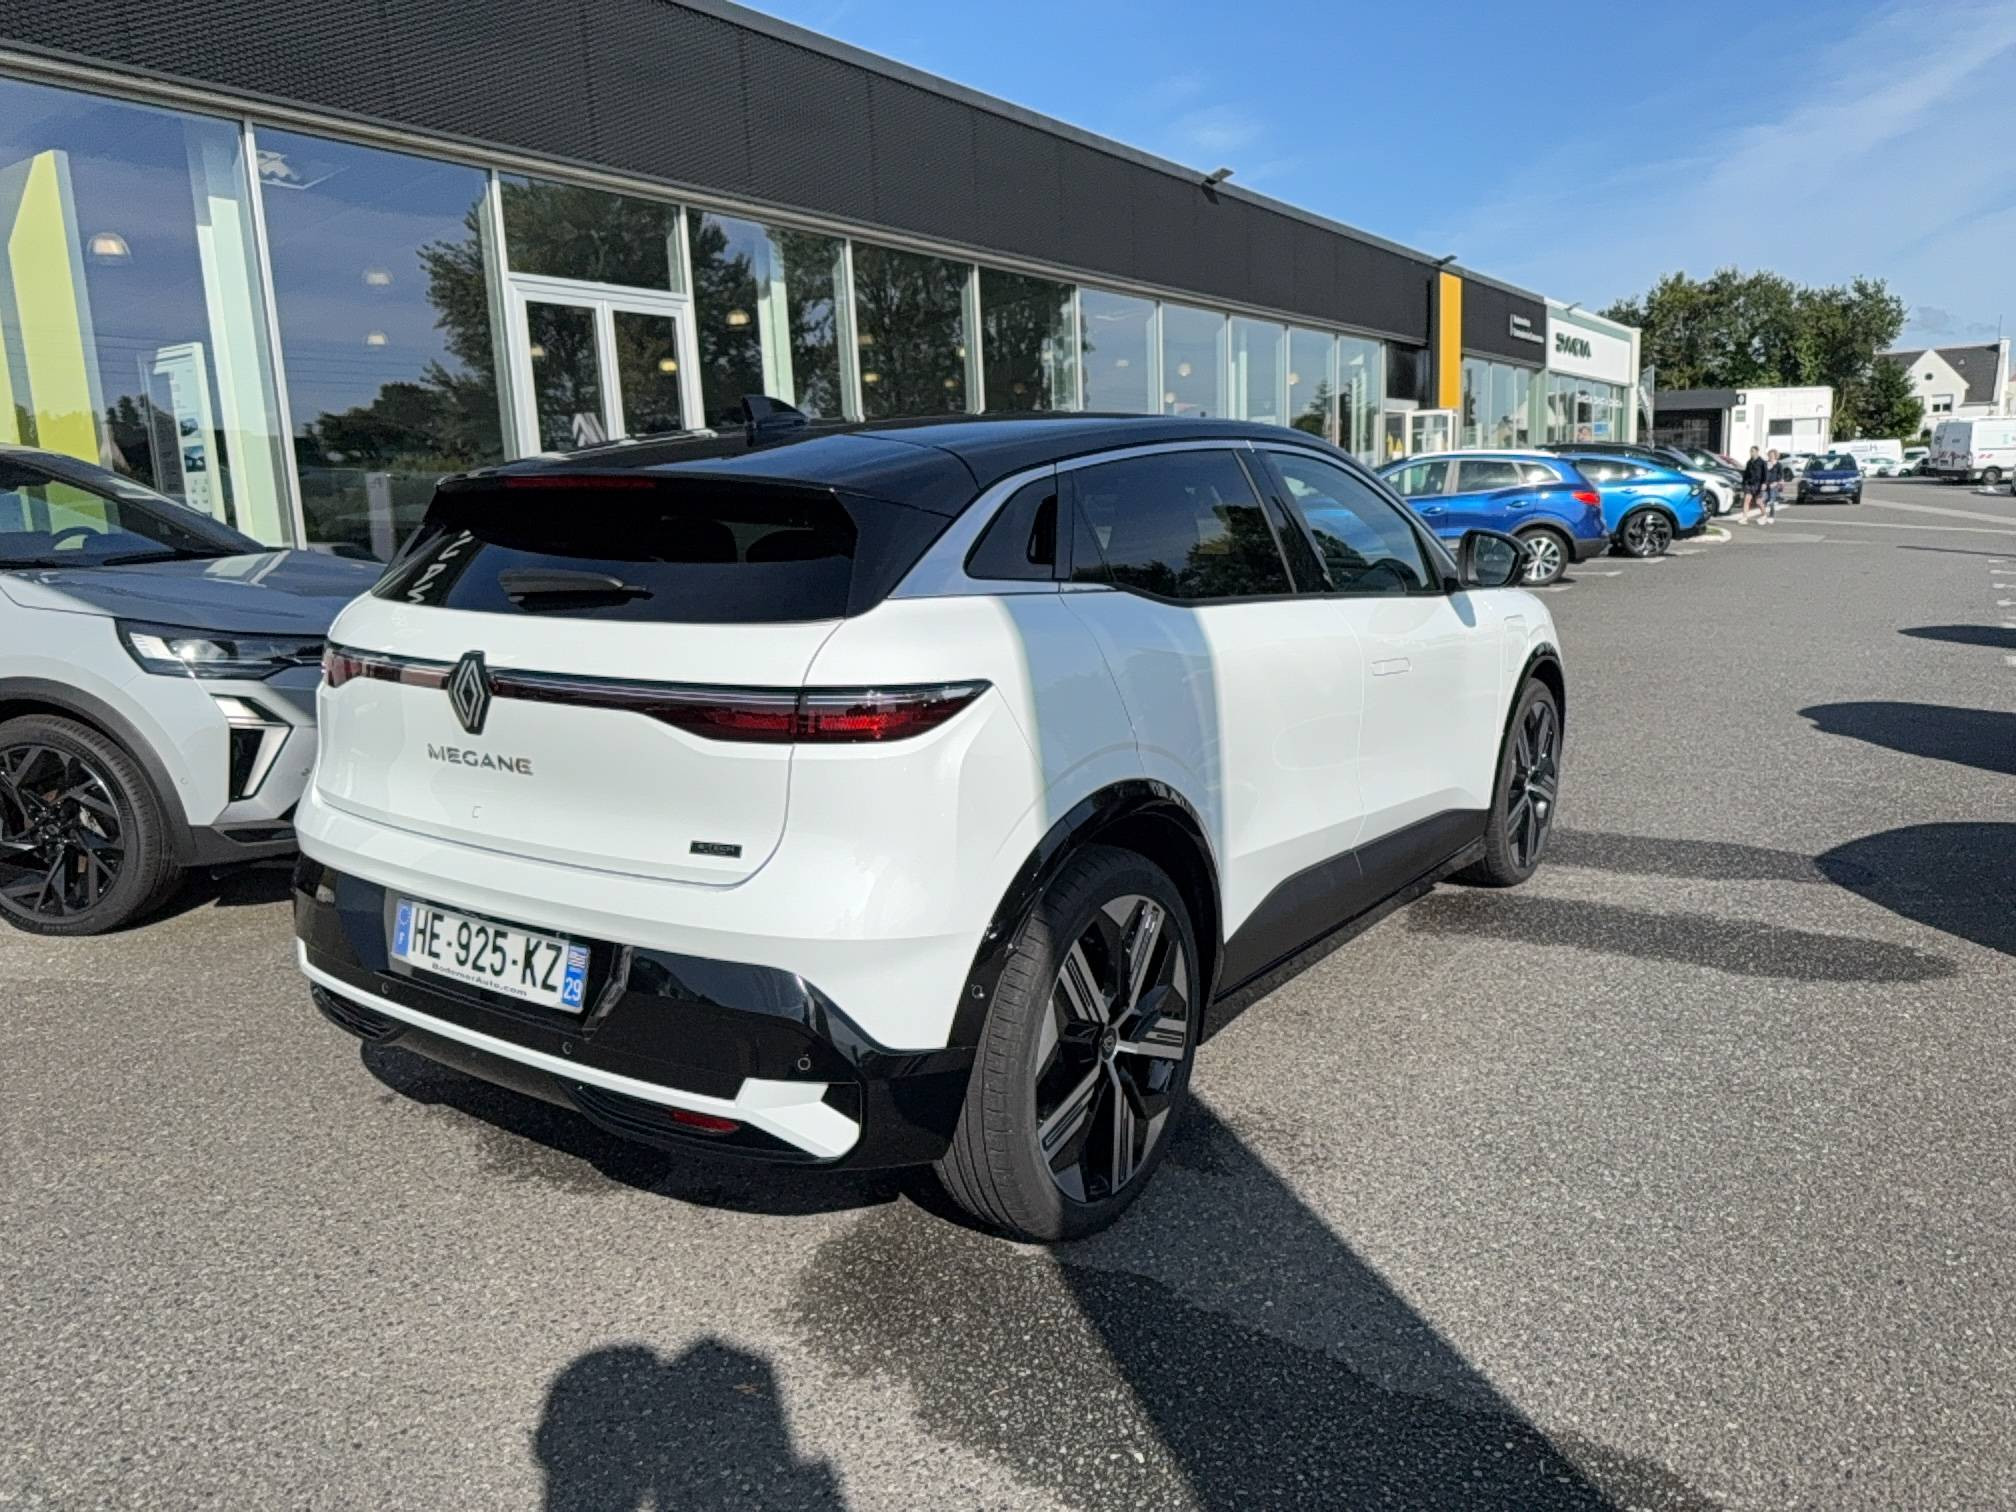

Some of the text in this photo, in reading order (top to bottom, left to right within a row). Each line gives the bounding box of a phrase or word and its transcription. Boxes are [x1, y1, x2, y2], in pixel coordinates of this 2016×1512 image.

[427, 743, 534, 776] MEGANE
[412, 907, 563, 993] HE-925-KZ
[563, 977, 583, 1001] 29
